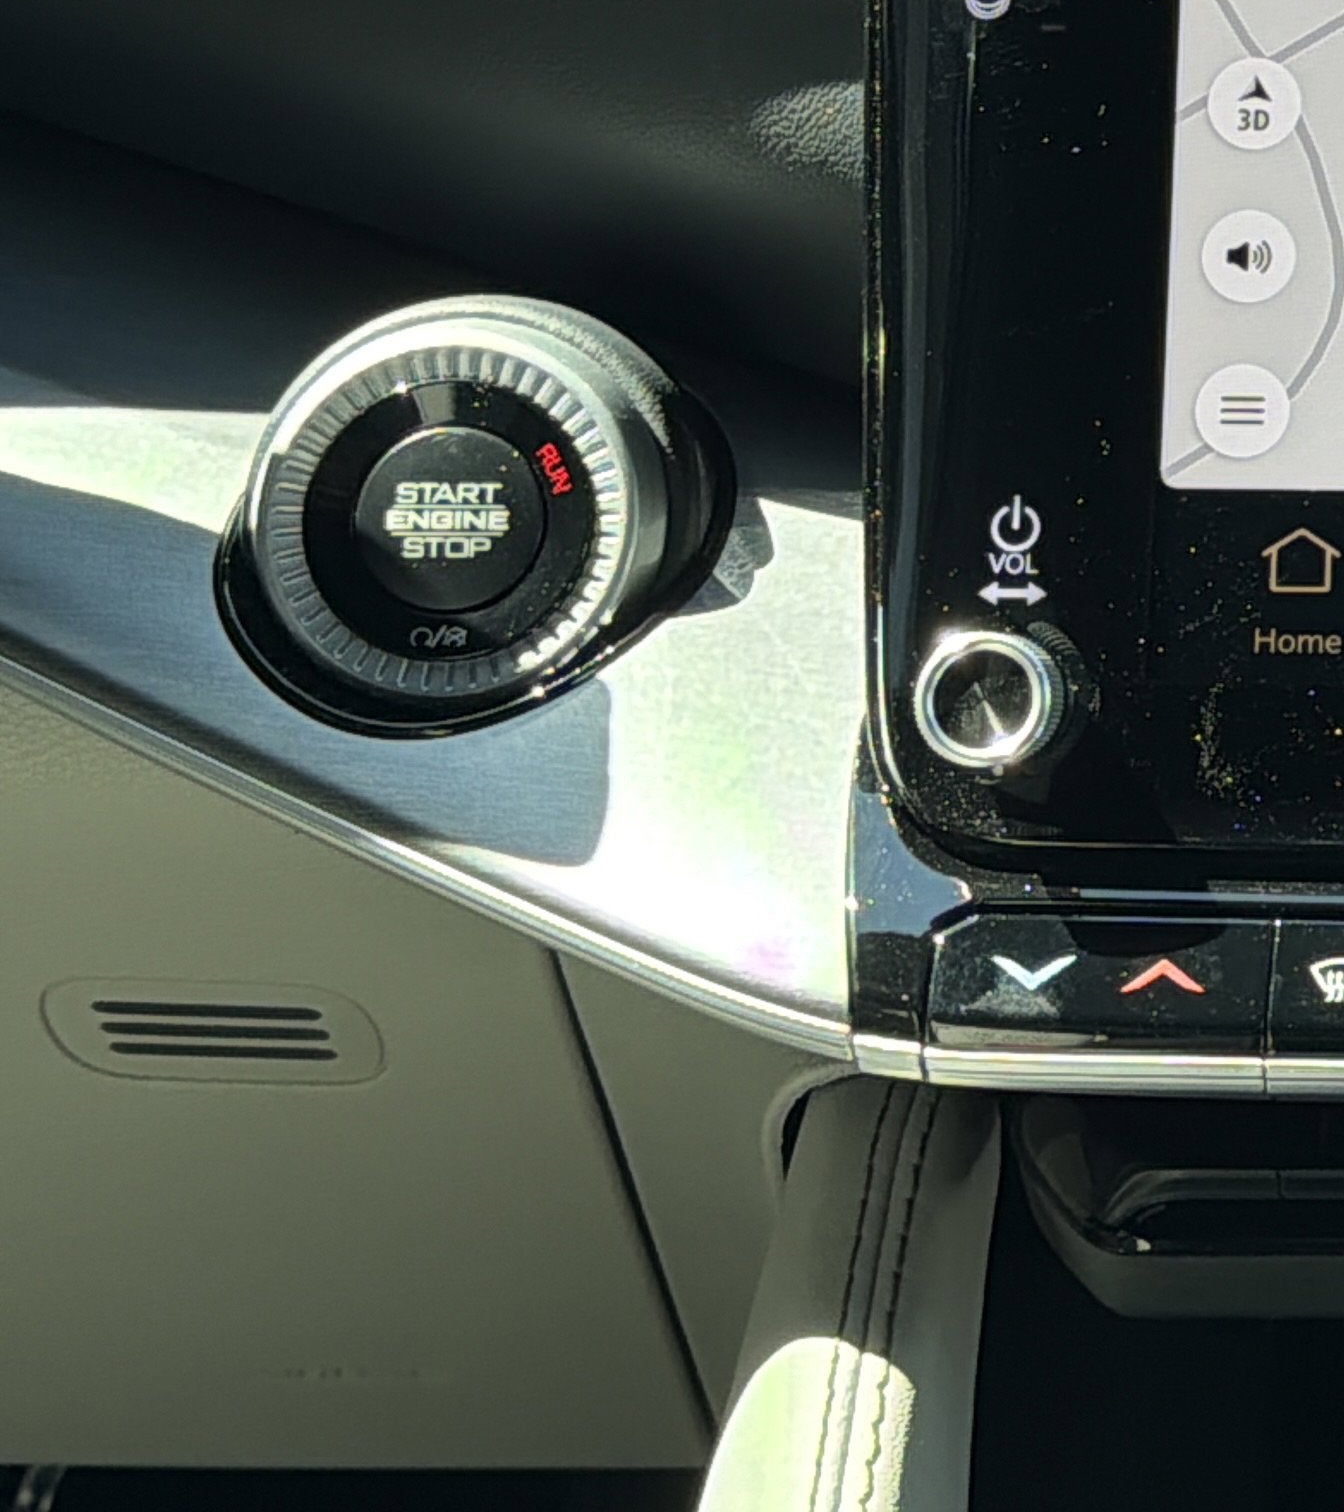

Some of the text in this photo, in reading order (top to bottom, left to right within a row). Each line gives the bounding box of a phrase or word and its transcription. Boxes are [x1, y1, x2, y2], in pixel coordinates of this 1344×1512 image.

[1237, 108, 1270, 132] 3D
[535, 442, 574, 496] RUN
[395, 482, 504, 504] START
[384, 509, 511, 531] ENGINE
[401, 537, 493, 559] STOP
[988, 554, 1039, 576] VOL
[1253, 627, 1342, 655] Home
